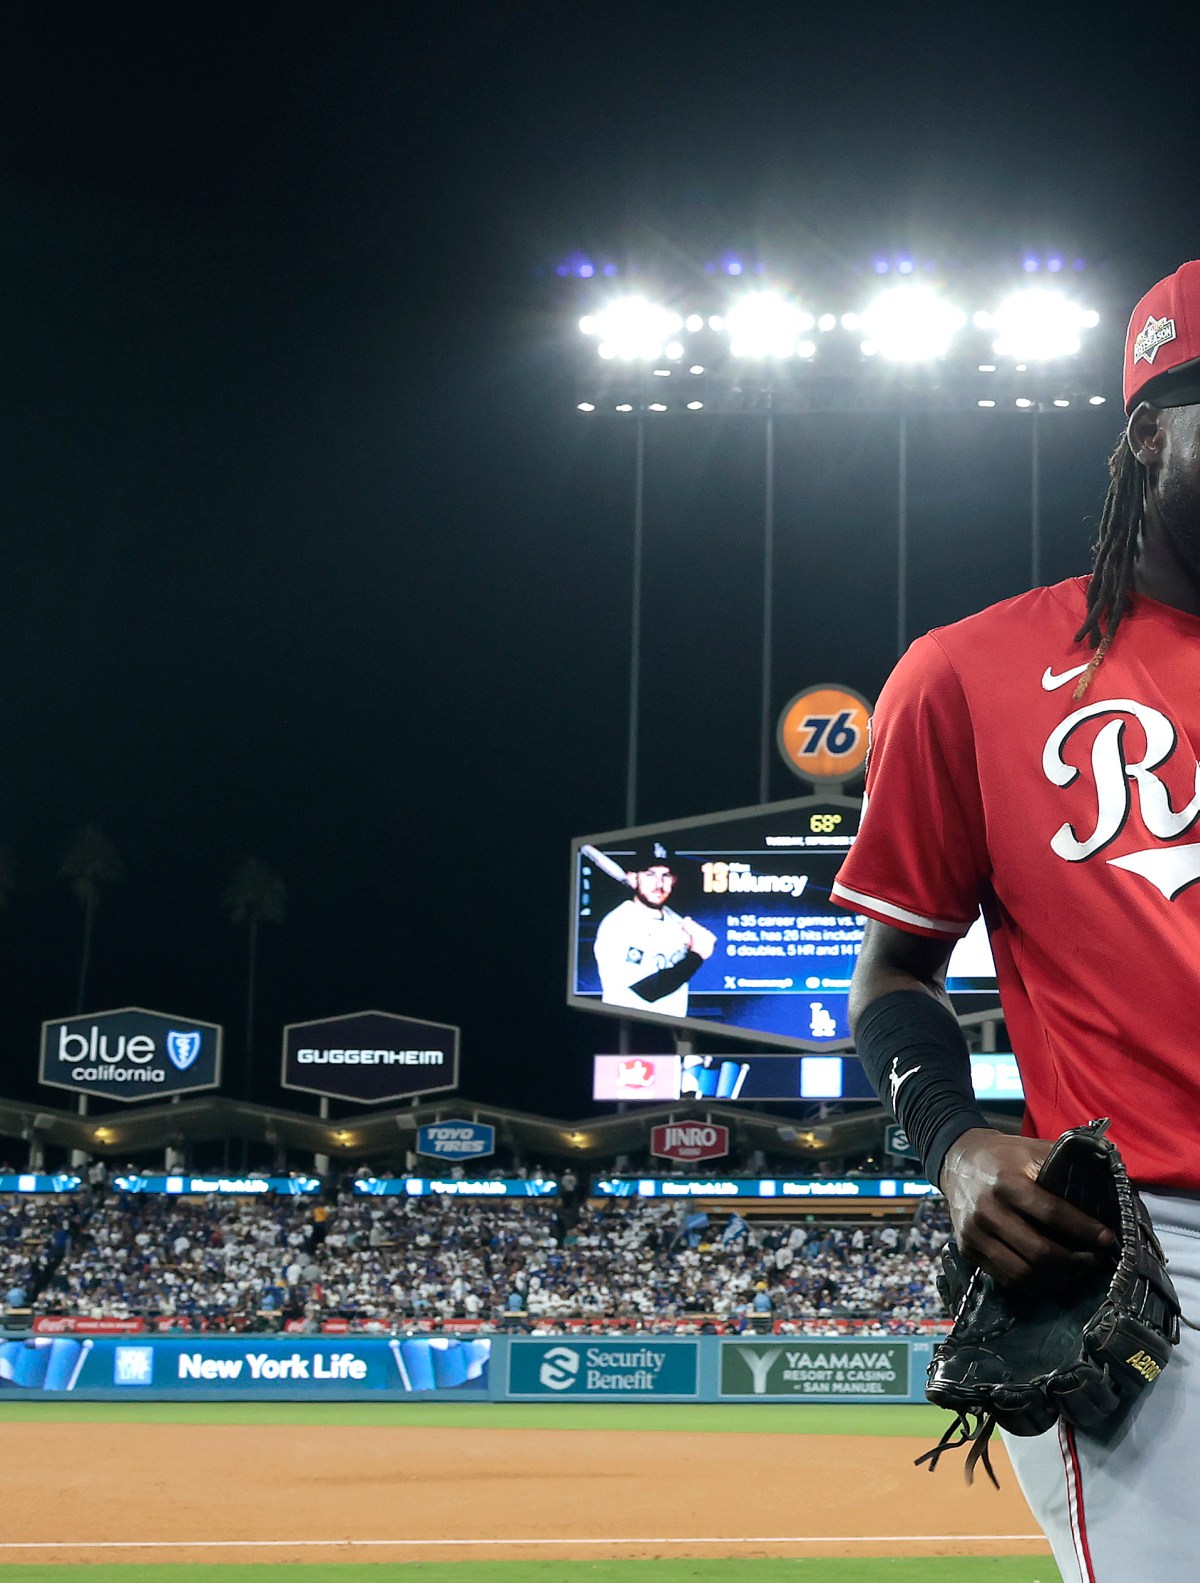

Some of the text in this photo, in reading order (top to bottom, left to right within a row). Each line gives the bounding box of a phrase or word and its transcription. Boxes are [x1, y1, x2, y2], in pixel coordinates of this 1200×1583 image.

[797, 708, 859, 758] 76
[809, 814, 842, 833] 68°
[701, 861, 729, 893] 13
[728, 872, 808, 897] Muncy
[757, 916, 796, 927] career
[796, 916, 834, 929] games
[855, 915, 868, 926] th
[726, 929, 760, 942] Reds,
[760, 929, 783, 942] has
[800, 929, 822, 941] hits
[737, 944, 786, 956] doubles,
[797, 944, 815, 956] HR
[816, 944, 840, 956] and
[59, 1025, 156, 1063] blue
[297, 1048, 444, 1065] GUGGENHEIM
[72, 1064, 165, 1082] california
[427, 1128, 474, 1140] TOYO
[664, 1127, 717, 1151] JINRO
[434, 1140, 485, 1152] TIRES
[178, 1354, 243, 1379] New
[245, 1354, 309, 1379] York
[313, 1354, 368, 1379] Life
[586, 1348, 666, 1372] Security
[586, 1370, 654, 1389] Benefit
[783, 1370, 896, 1381] RESORT & CASINO
[803, 1382, 829, 1393] SAN
[832, 1382, 885, 1393] MANUEL
